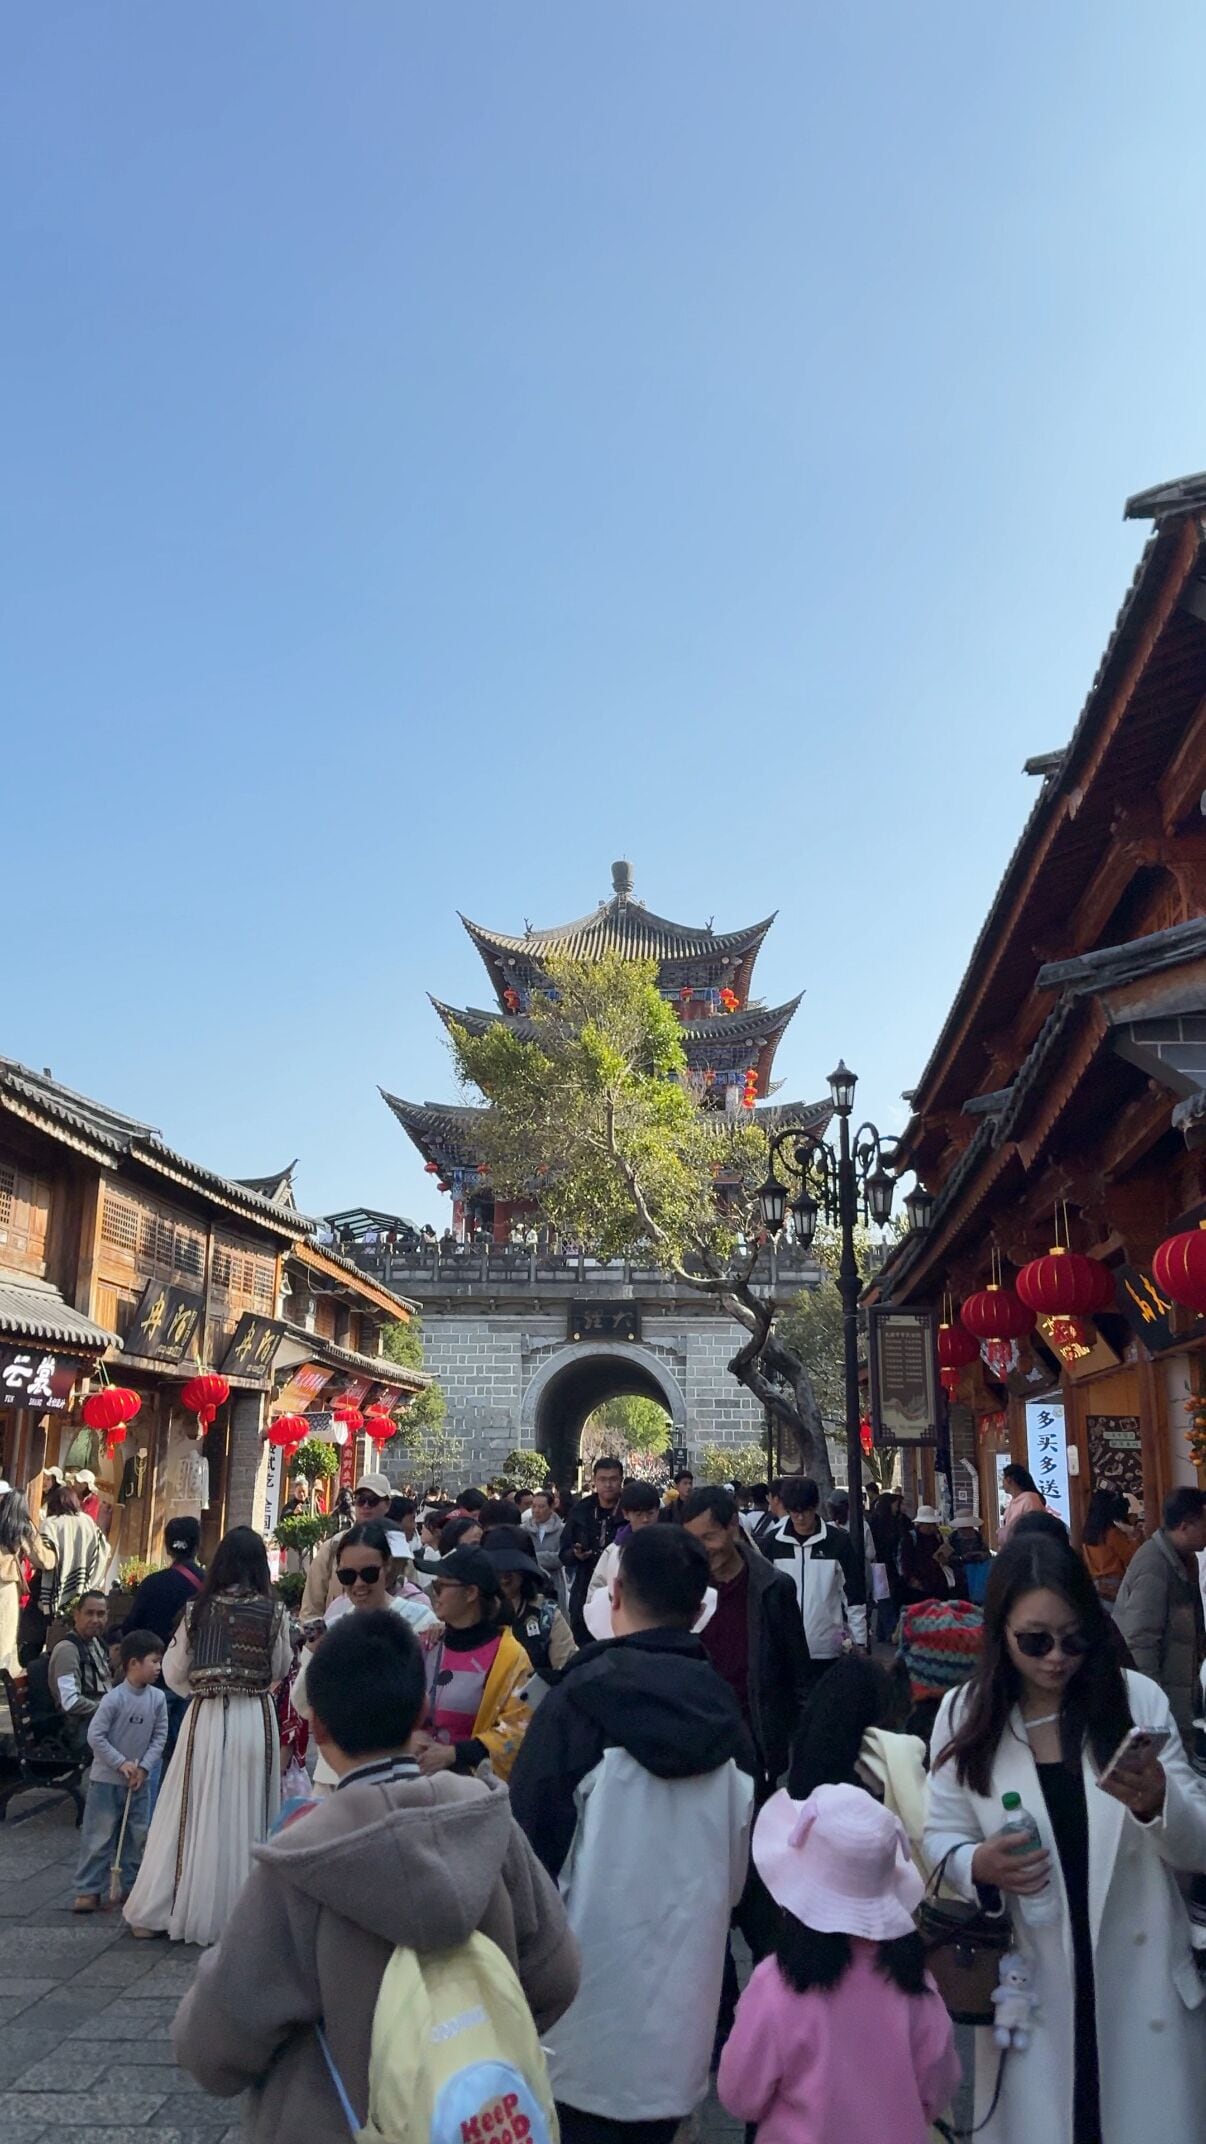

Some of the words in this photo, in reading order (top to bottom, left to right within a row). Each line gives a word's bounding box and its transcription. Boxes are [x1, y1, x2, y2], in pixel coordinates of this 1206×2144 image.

[2, 1354, 56, 1397] 云裳
[1037, 1410, 1062, 1499] 多买多送
